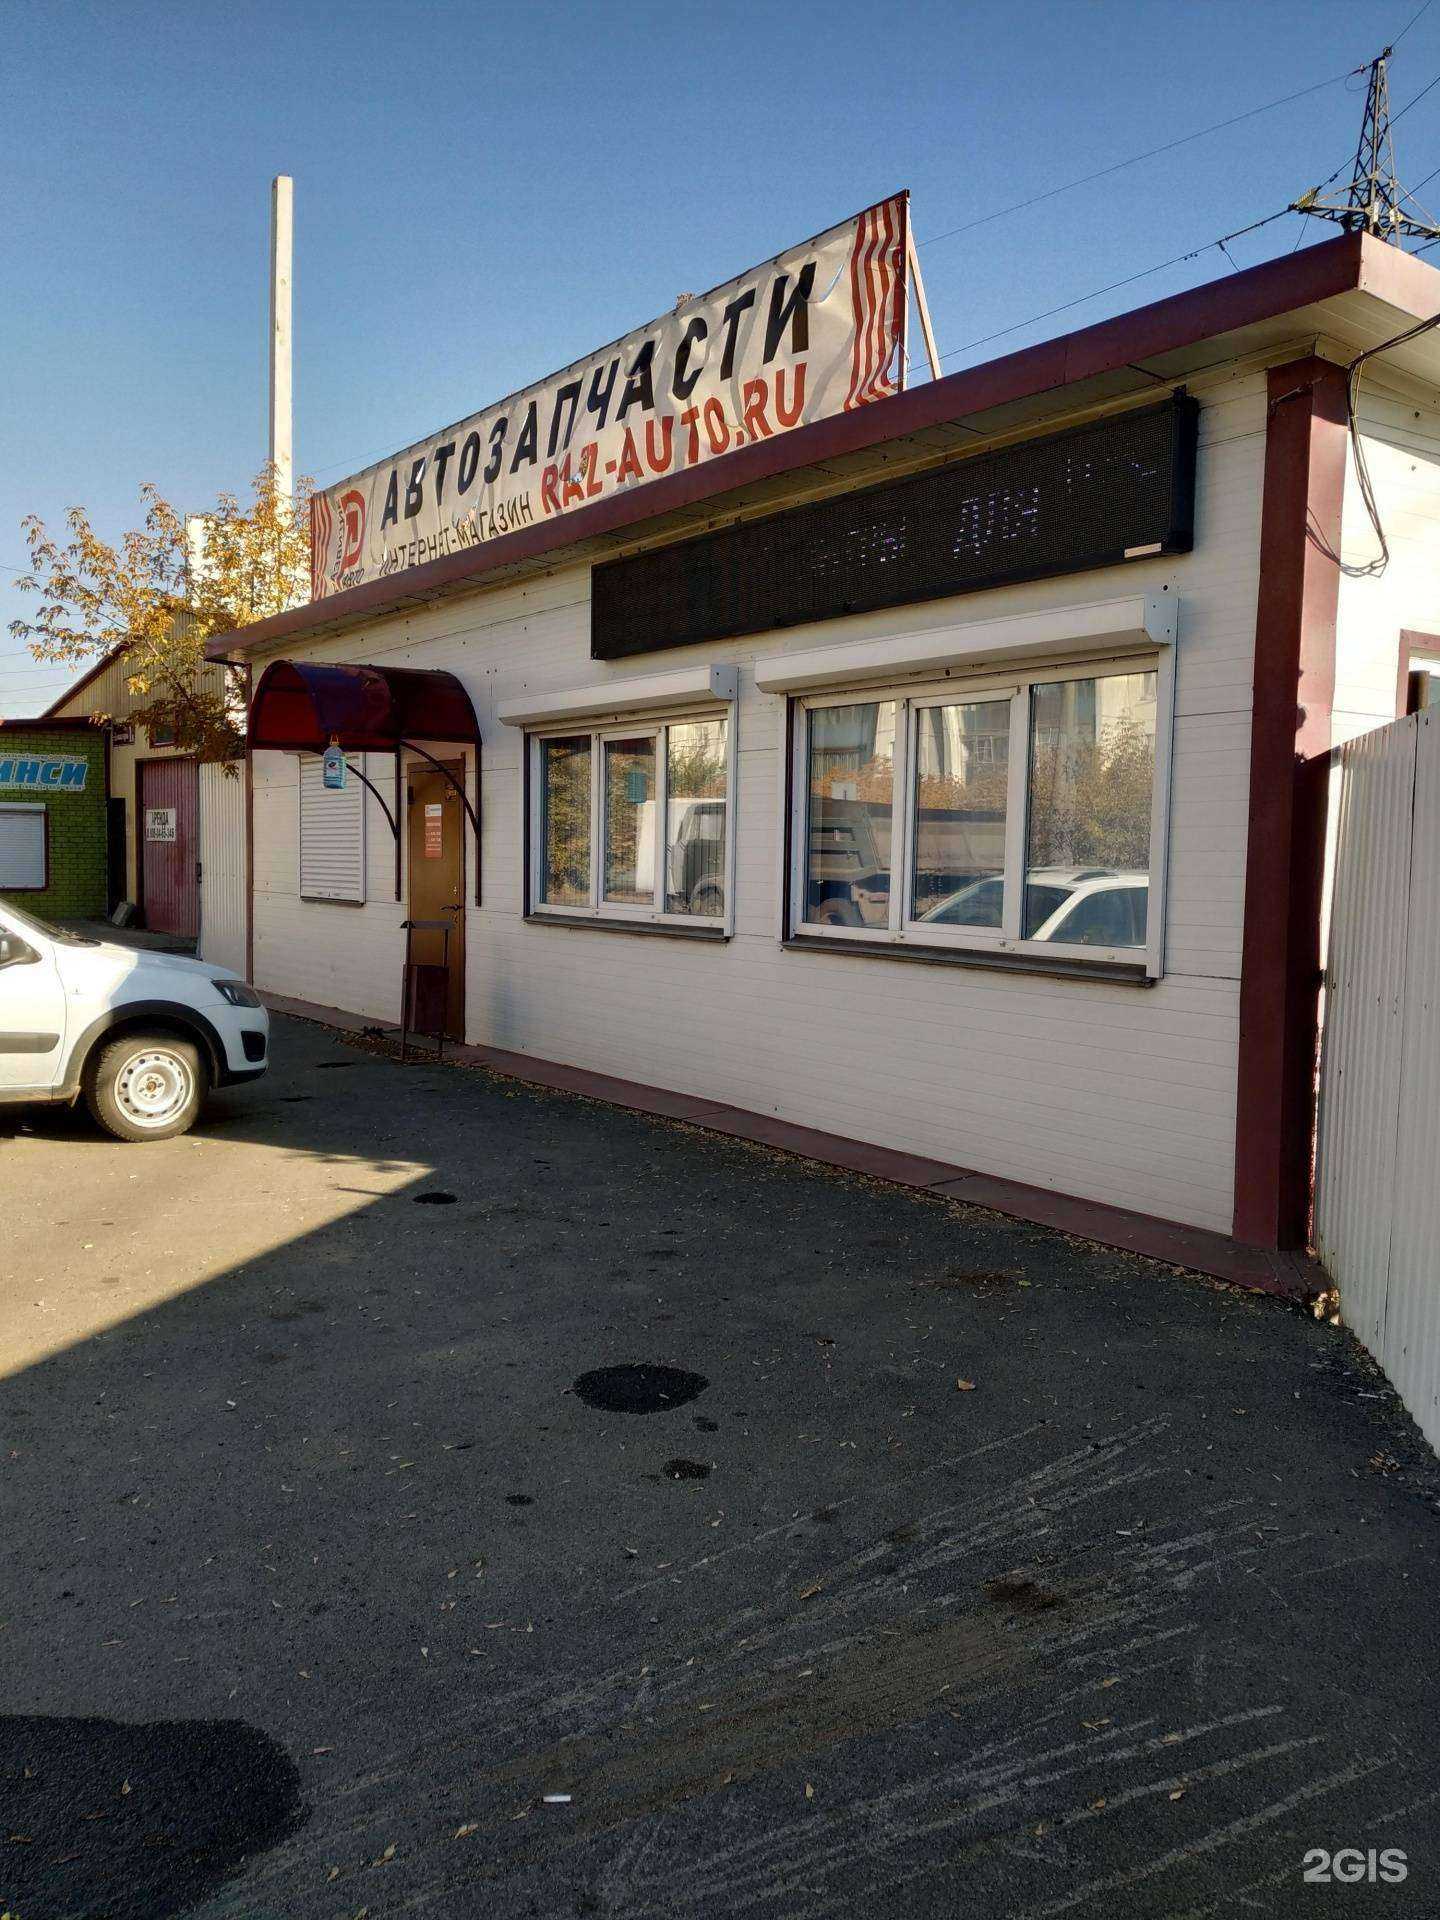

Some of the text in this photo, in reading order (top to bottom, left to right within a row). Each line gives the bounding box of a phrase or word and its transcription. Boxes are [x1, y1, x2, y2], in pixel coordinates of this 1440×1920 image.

[381, 261, 817, 531] АВТОЗАПЧАСТИ
[541, 362, 808, 514] RAZ-AUTO.RU
[379, 491, 534, 576] ИНТЕРНЕТ-МАГАЗИН
